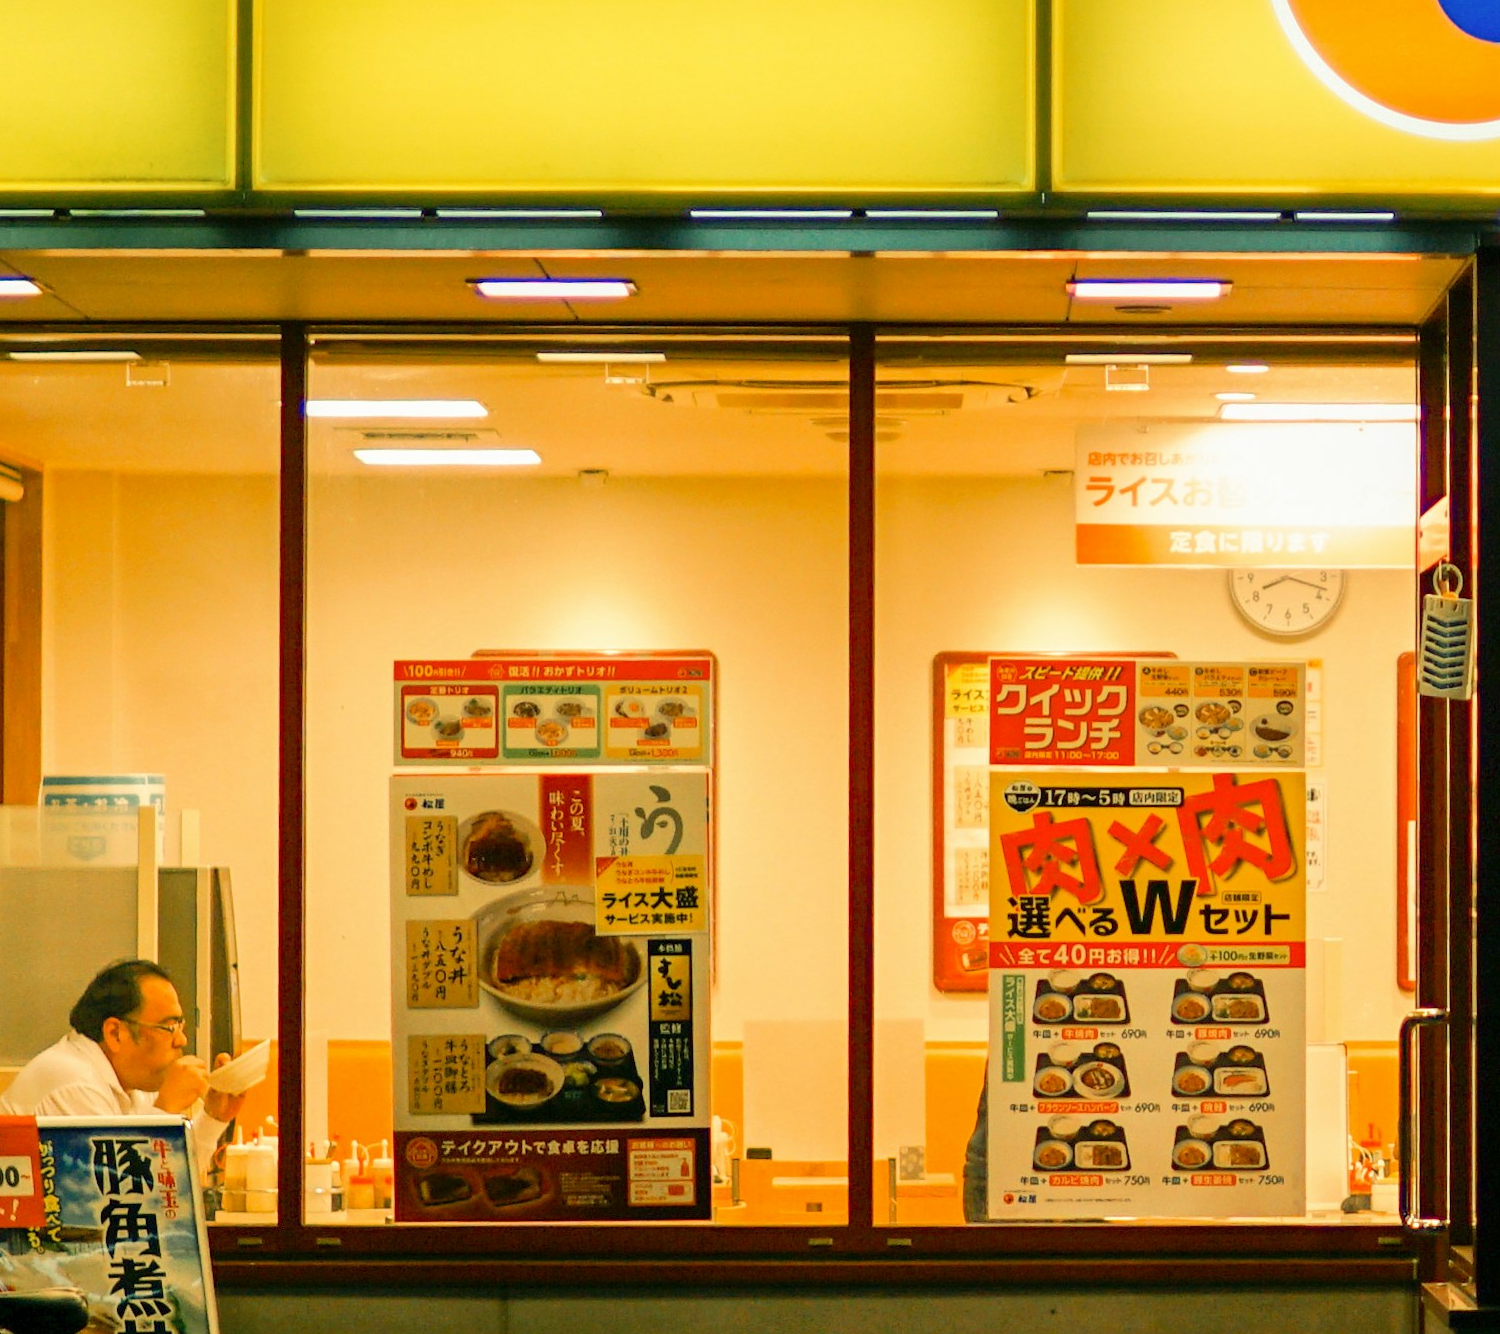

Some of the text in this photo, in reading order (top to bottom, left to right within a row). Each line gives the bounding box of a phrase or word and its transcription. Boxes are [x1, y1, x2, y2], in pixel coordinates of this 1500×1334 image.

[996, 683, 1128, 716] クイック
[1024, 717, 1121, 750] ランチ
[1131, 790, 1180, 804] 店内限定
[602, 886, 699, 909] ライス大盛
[1007, 879, 1291, 939] 選べるWセット
[441, 1139, 620, 1155] テイクアウトで食卓を応援
